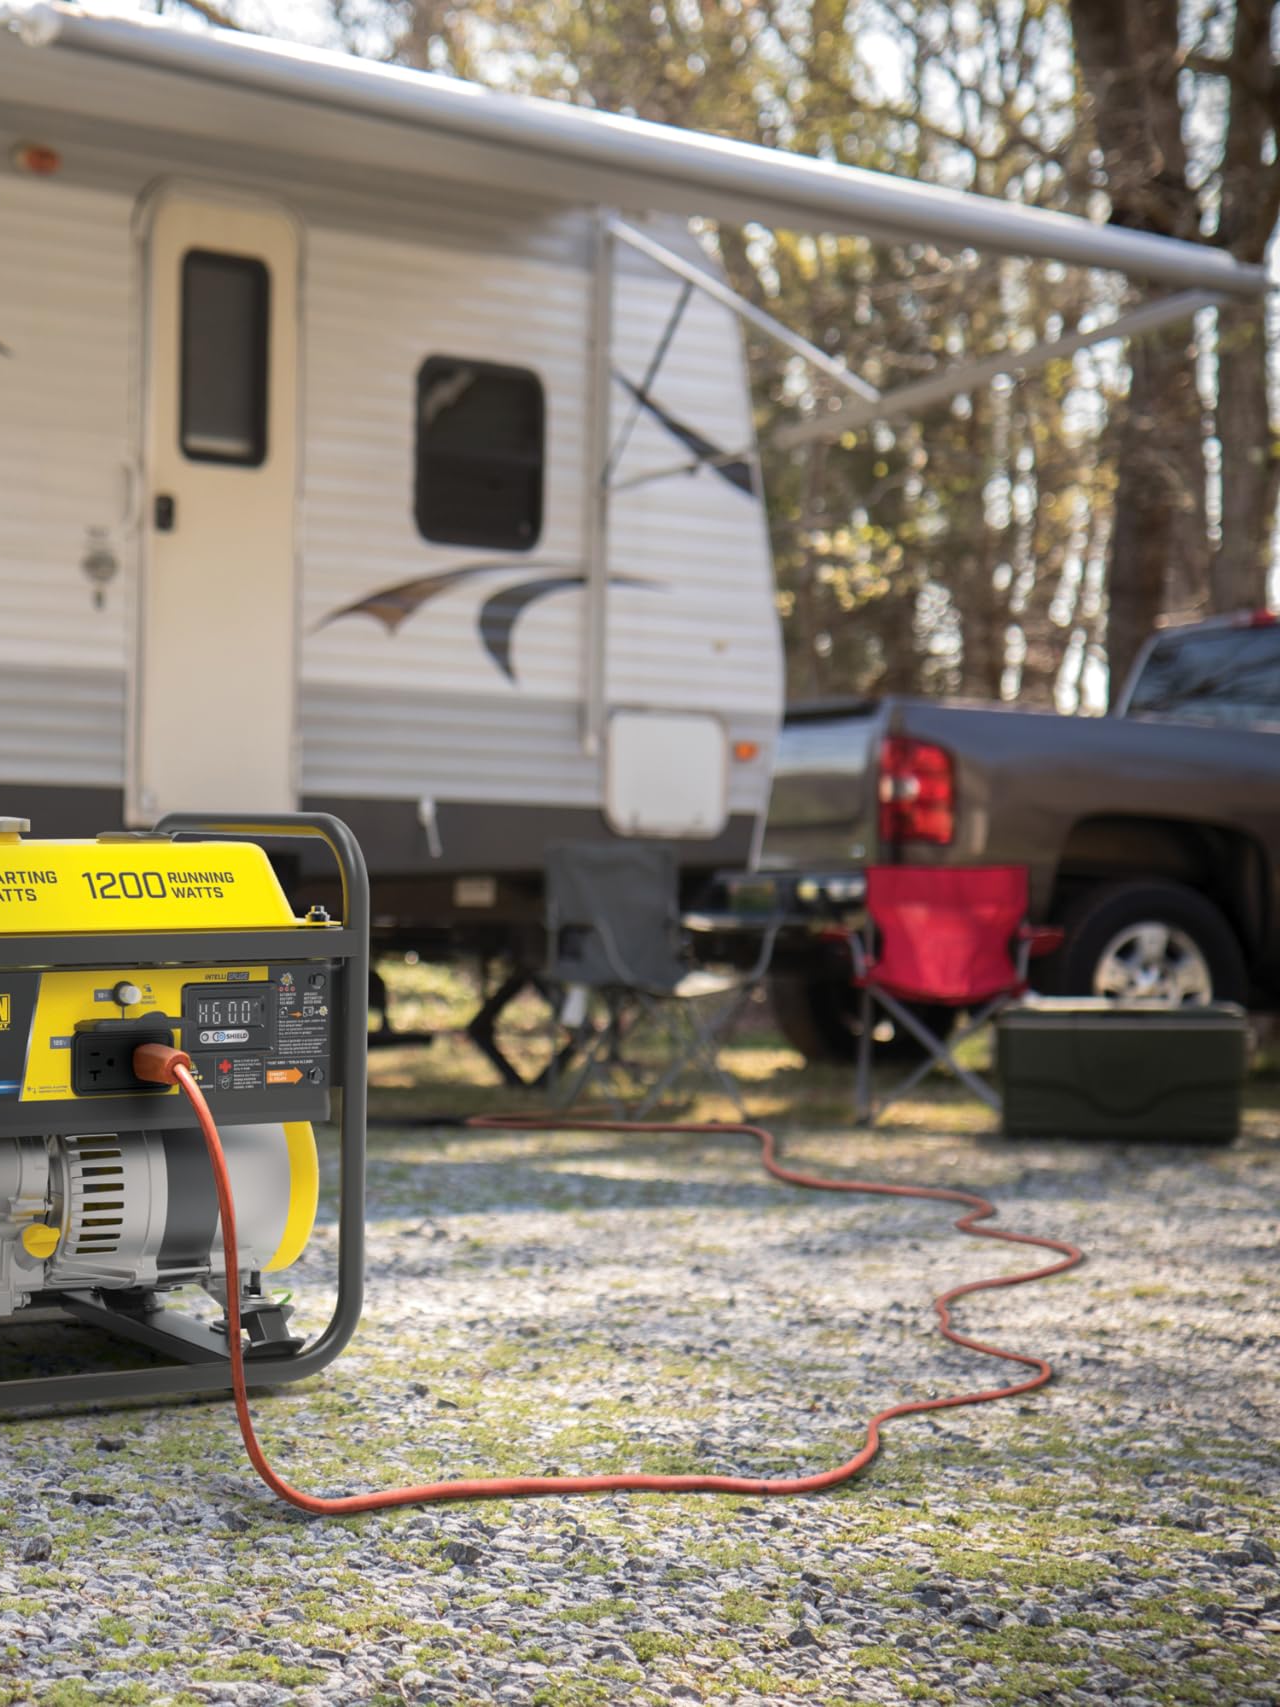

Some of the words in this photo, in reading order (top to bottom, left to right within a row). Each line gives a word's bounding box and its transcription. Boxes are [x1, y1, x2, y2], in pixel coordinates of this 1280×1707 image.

[167, 872, 235, 884] RUNNING
[81, 872, 167, 899] 1200
[171, 887, 224, 899] WATTS
